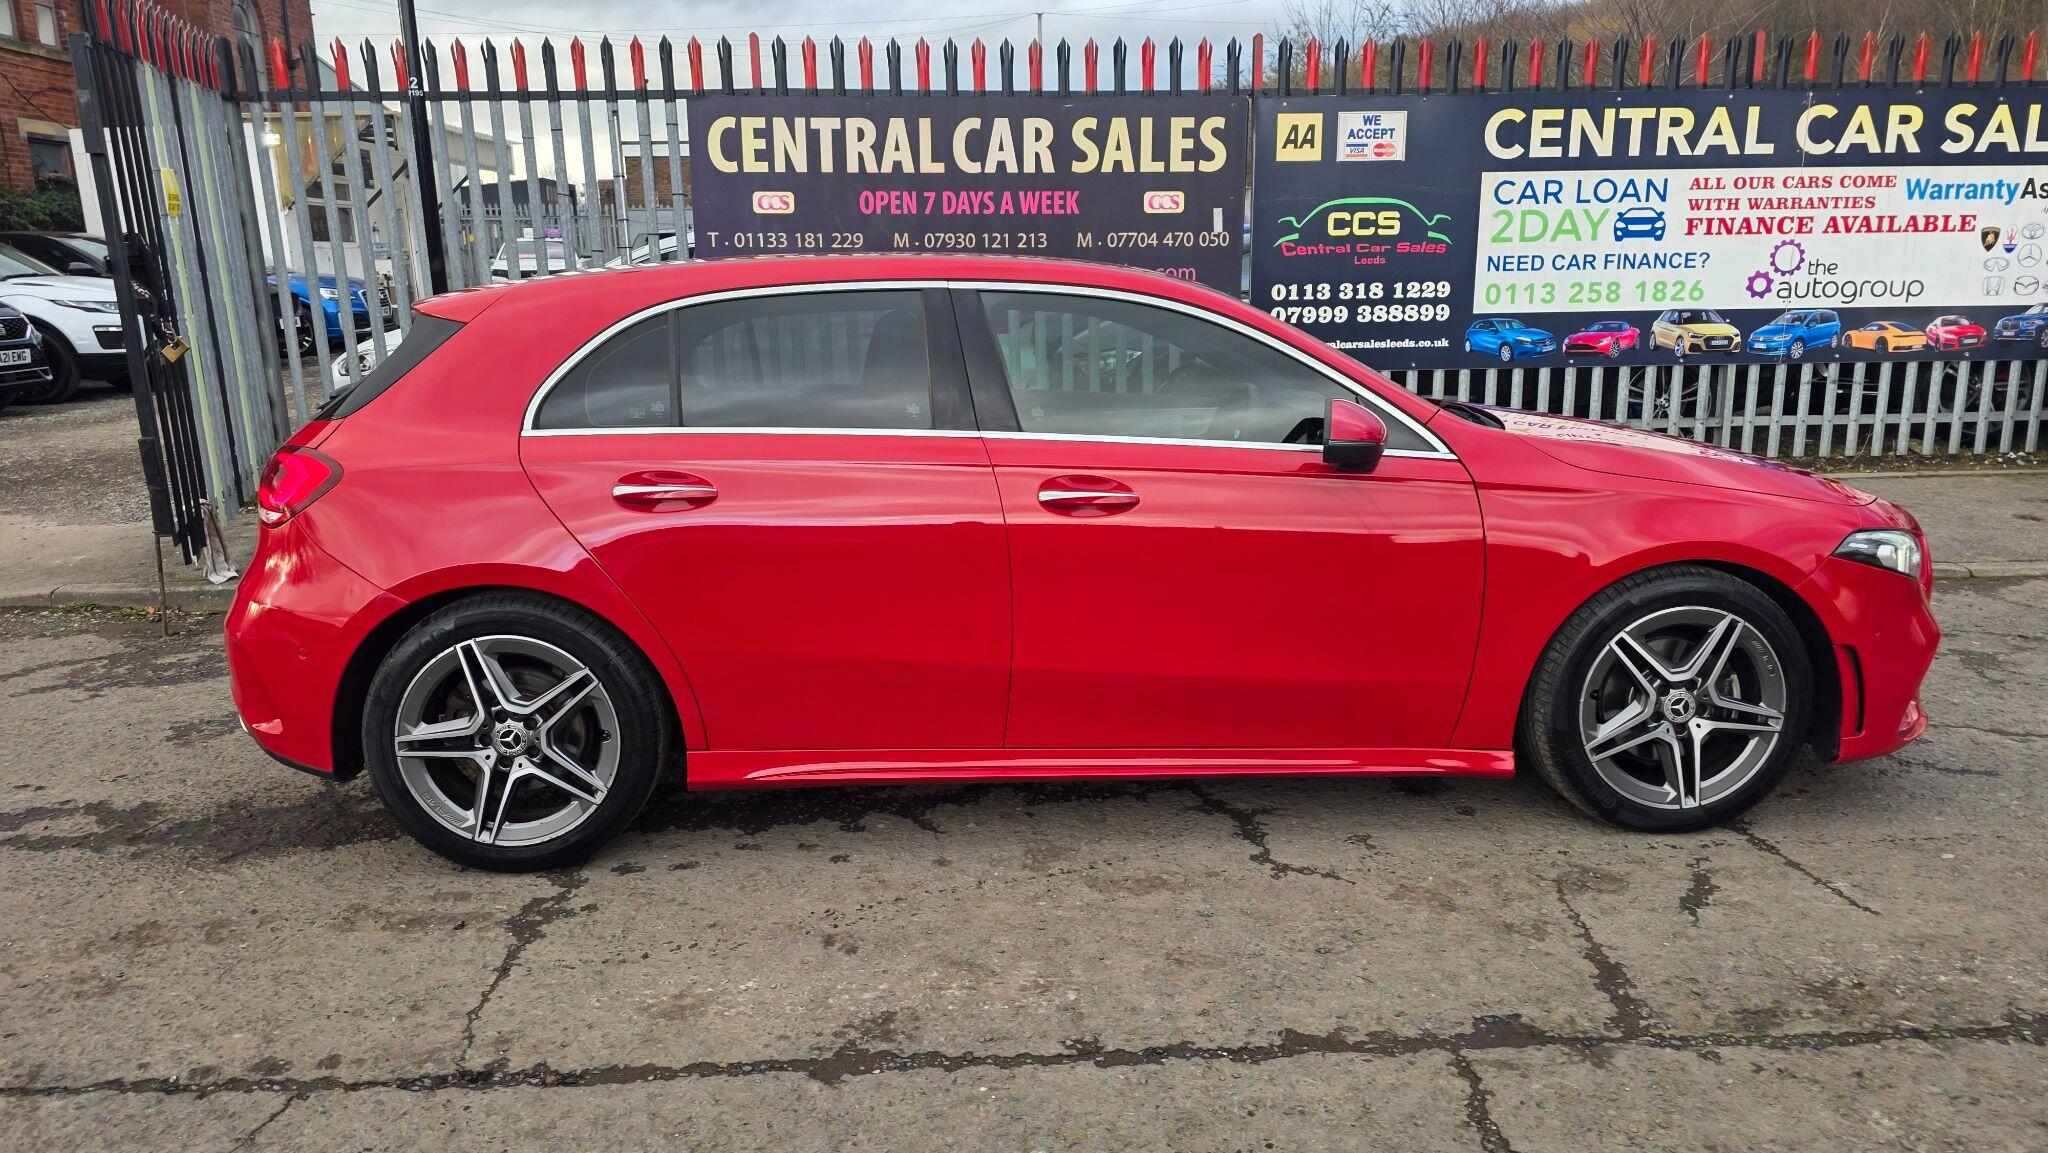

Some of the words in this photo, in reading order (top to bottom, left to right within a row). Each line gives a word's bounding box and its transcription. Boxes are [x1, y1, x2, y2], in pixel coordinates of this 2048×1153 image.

[410, 77, 418, 88] 2
[1363, 115, 1381, 126] WE
[1282, 124, 1315, 149] AA
[1348, 128, 1395, 139] ACCEPT
[1485, 106, 1774, 159] CENTRAL
[1796, 104, 1923, 155] CAR
[708, 117, 945, 173] CENTRAL
[953, 118, 1055, 173] CAR
[1072, 117, 1227, 173] SALES
[1349, 146, 1365, 154] VISA
[1689, 178, 1725, 190] ALL
[1734, 177, 1775, 189] OUR
[1789, 176, 1832, 188] CARS
[1840, 176, 1897, 188] COME
[1494, 180, 1563, 205] CAR
[1576, 178, 1668, 203] LOAN
[757, 195, 790, 210] CCS
[860, 191, 917, 214] OPEN
[924, 192, 935, 214] 7
[943, 191, 995, 214] DAYS
[1000, 191, 1014, 214] A
[1019, 191, 1079, 214] WEEK
[1149, 195, 1179, 209] CCS
[1688, 198, 1740, 211] WITH
[1748, 196, 1875, 210] WARRANTIES
[1328, 211, 1400, 236] CCS
[1491, 208, 1609, 243] 2DAY
[1685, 216, 1814, 235] FINANCE
[1822, 215, 1976, 233] AVAILABLE
[735, 233, 787, 247] 01133
[795, 233, 822, 247] 181
[831, 233, 863, 248] 229
[925, 233, 975, 248] 07930
[983, 233, 1008, 248] 121
[1018, 233, 1047, 247] 213
[1108, 233, 1158, 247] 07704
[1163, 232, 1193, 246] 470
[1199, 233, 1229, 246] 050
[1282, 241, 1350, 256] Central
[1356, 244, 1391, 252] Car
[1397, 241, 1447, 253] Sales
[1355, 256, 1385, 264] Leeds
[1488, 255, 1544, 272] NEED
[1552, 254, 1596, 270] CAR
[1604, 252, 1710, 269] FINANCE?
[1808, 259, 1838, 275] the
[1271, 283, 1330, 300] 0113
[1339, 282, 1383, 299] 318
[1394, 281, 1450, 298] 1229
[1486, 283, 1555, 305] 0113
[1569, 281, 1620, 303] 258
[1635, 280, 1704, 302] 1826
[1777, 278, 1924, 304] autogroup
[1271, 306, 1348, 323] 07999
[1357, 304, 1450, 322] 388899
[12, 351, 26, 362] EWG
